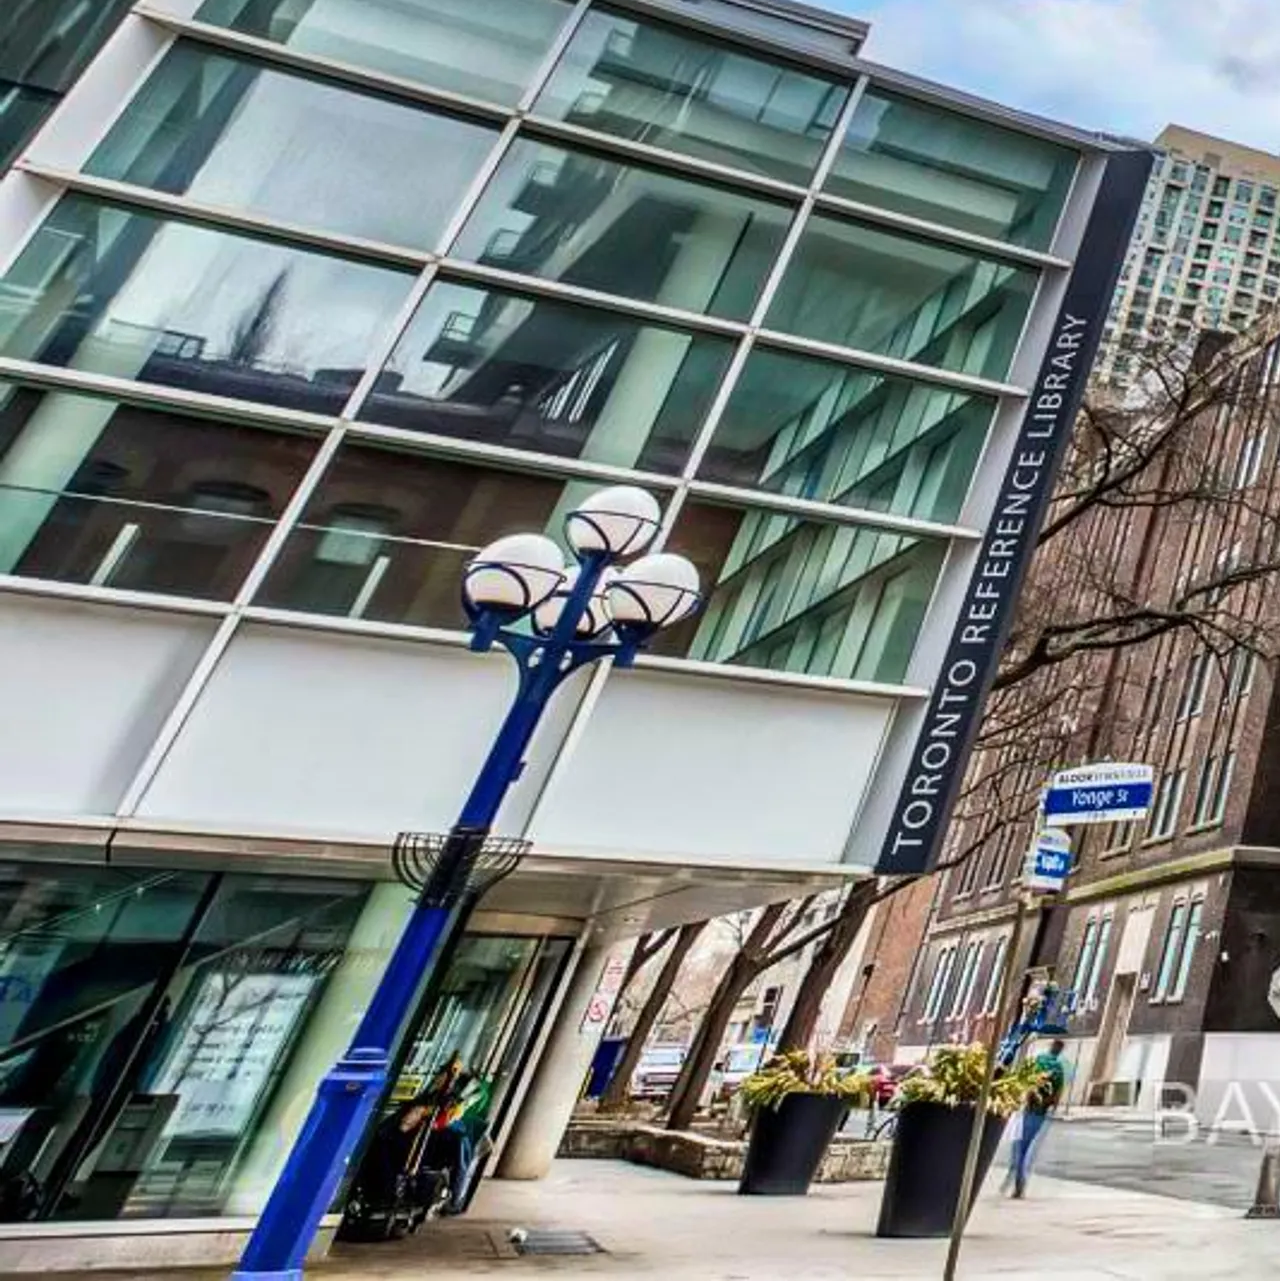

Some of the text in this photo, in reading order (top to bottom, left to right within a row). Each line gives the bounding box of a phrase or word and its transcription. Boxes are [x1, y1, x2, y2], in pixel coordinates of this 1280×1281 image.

[891, 314, 1086, 855] TORONTO REFERENCE LIBRARY
[1072, 787, 1114, 808] Yonge
